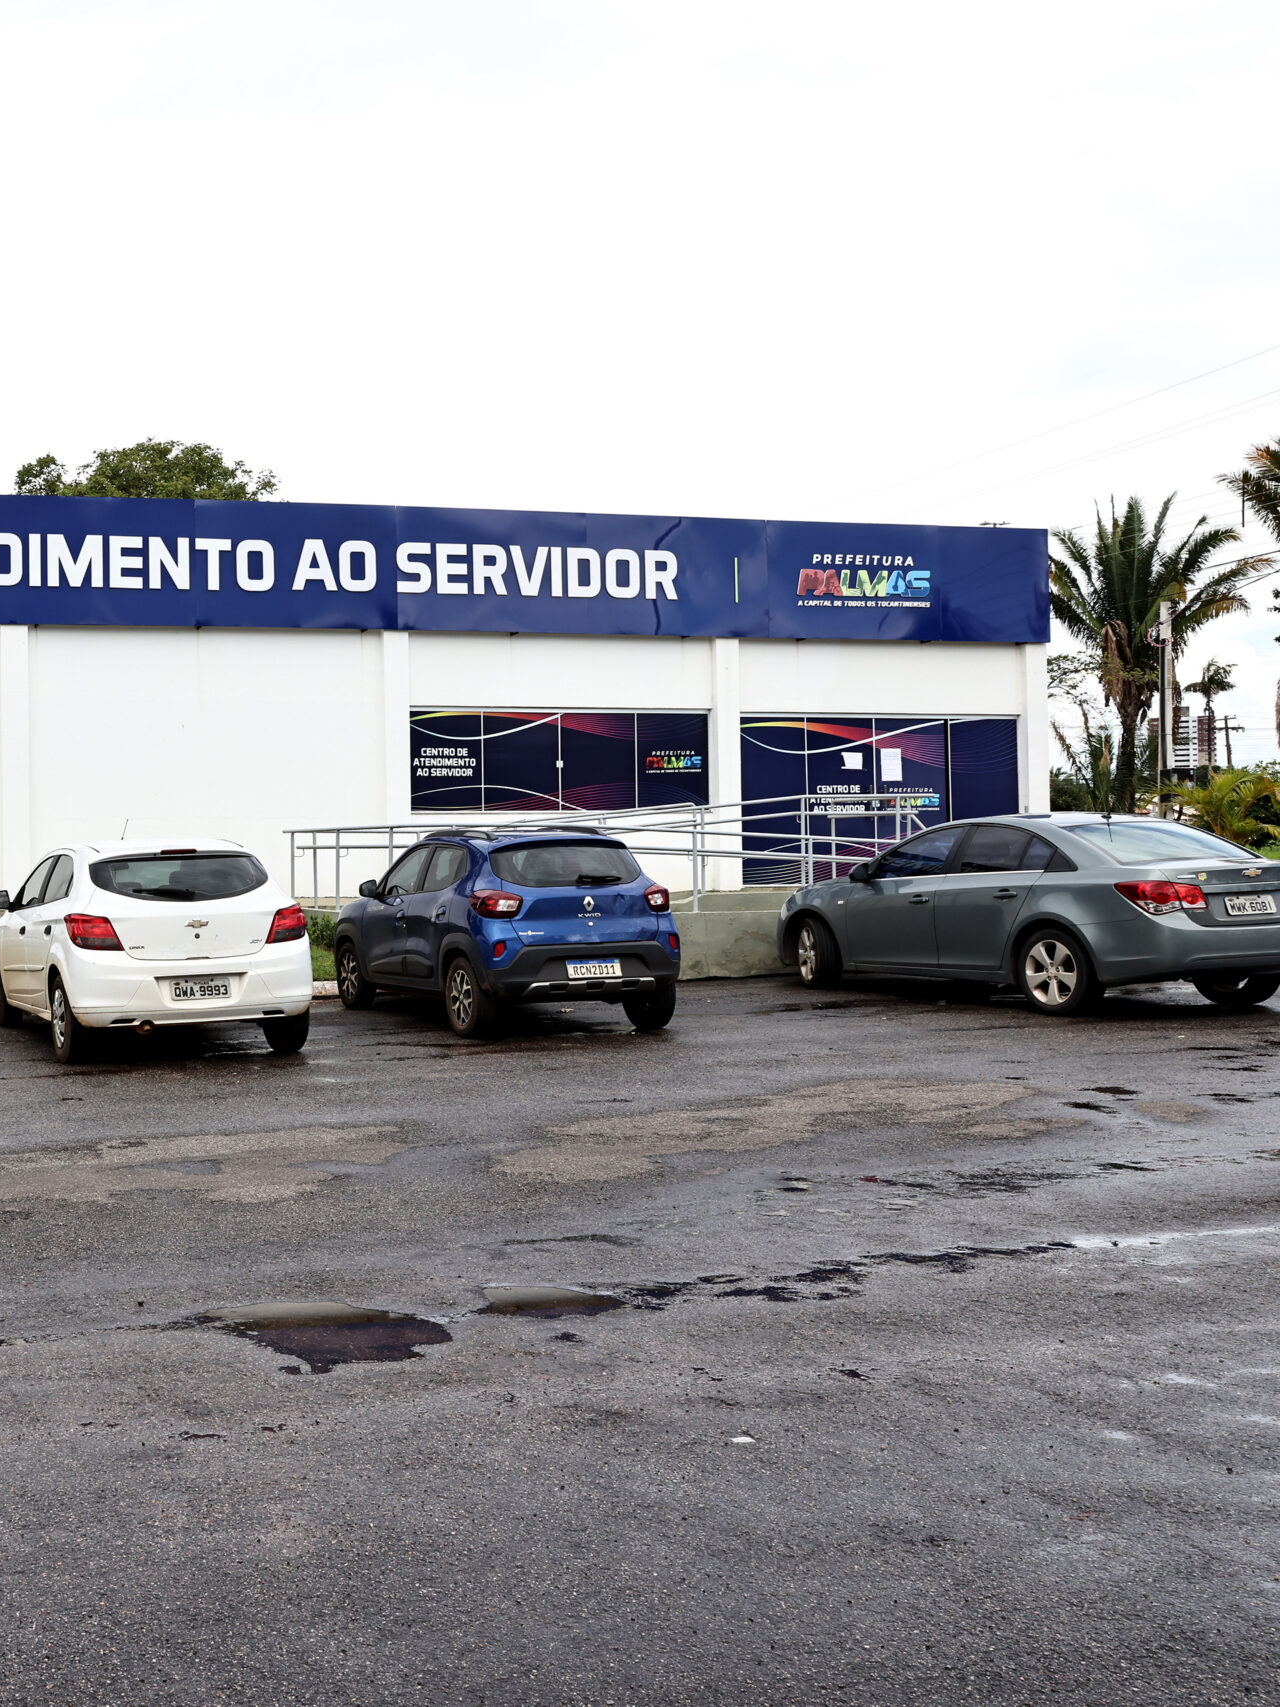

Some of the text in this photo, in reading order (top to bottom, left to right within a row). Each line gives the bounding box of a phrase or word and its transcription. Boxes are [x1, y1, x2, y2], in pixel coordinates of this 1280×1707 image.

[813, 554, 913, 566] PREFEITURA
[292, 539, 376, 591] AO
[396, 542, 678, 600] SERVIDOR
[796, 568, 931, 597] PALMAS
[421, 748, 468, 756] CENTRO DE
[413, 758, 476, 766] ATENDIMENTO
[646, 756, 702, 768] PALMAS
[417, 768, 473, 776] AO SERVIDOR
[817, 785, 861, 793] CENTRO DE
[573, 965, 616, 976] RCN2D11
